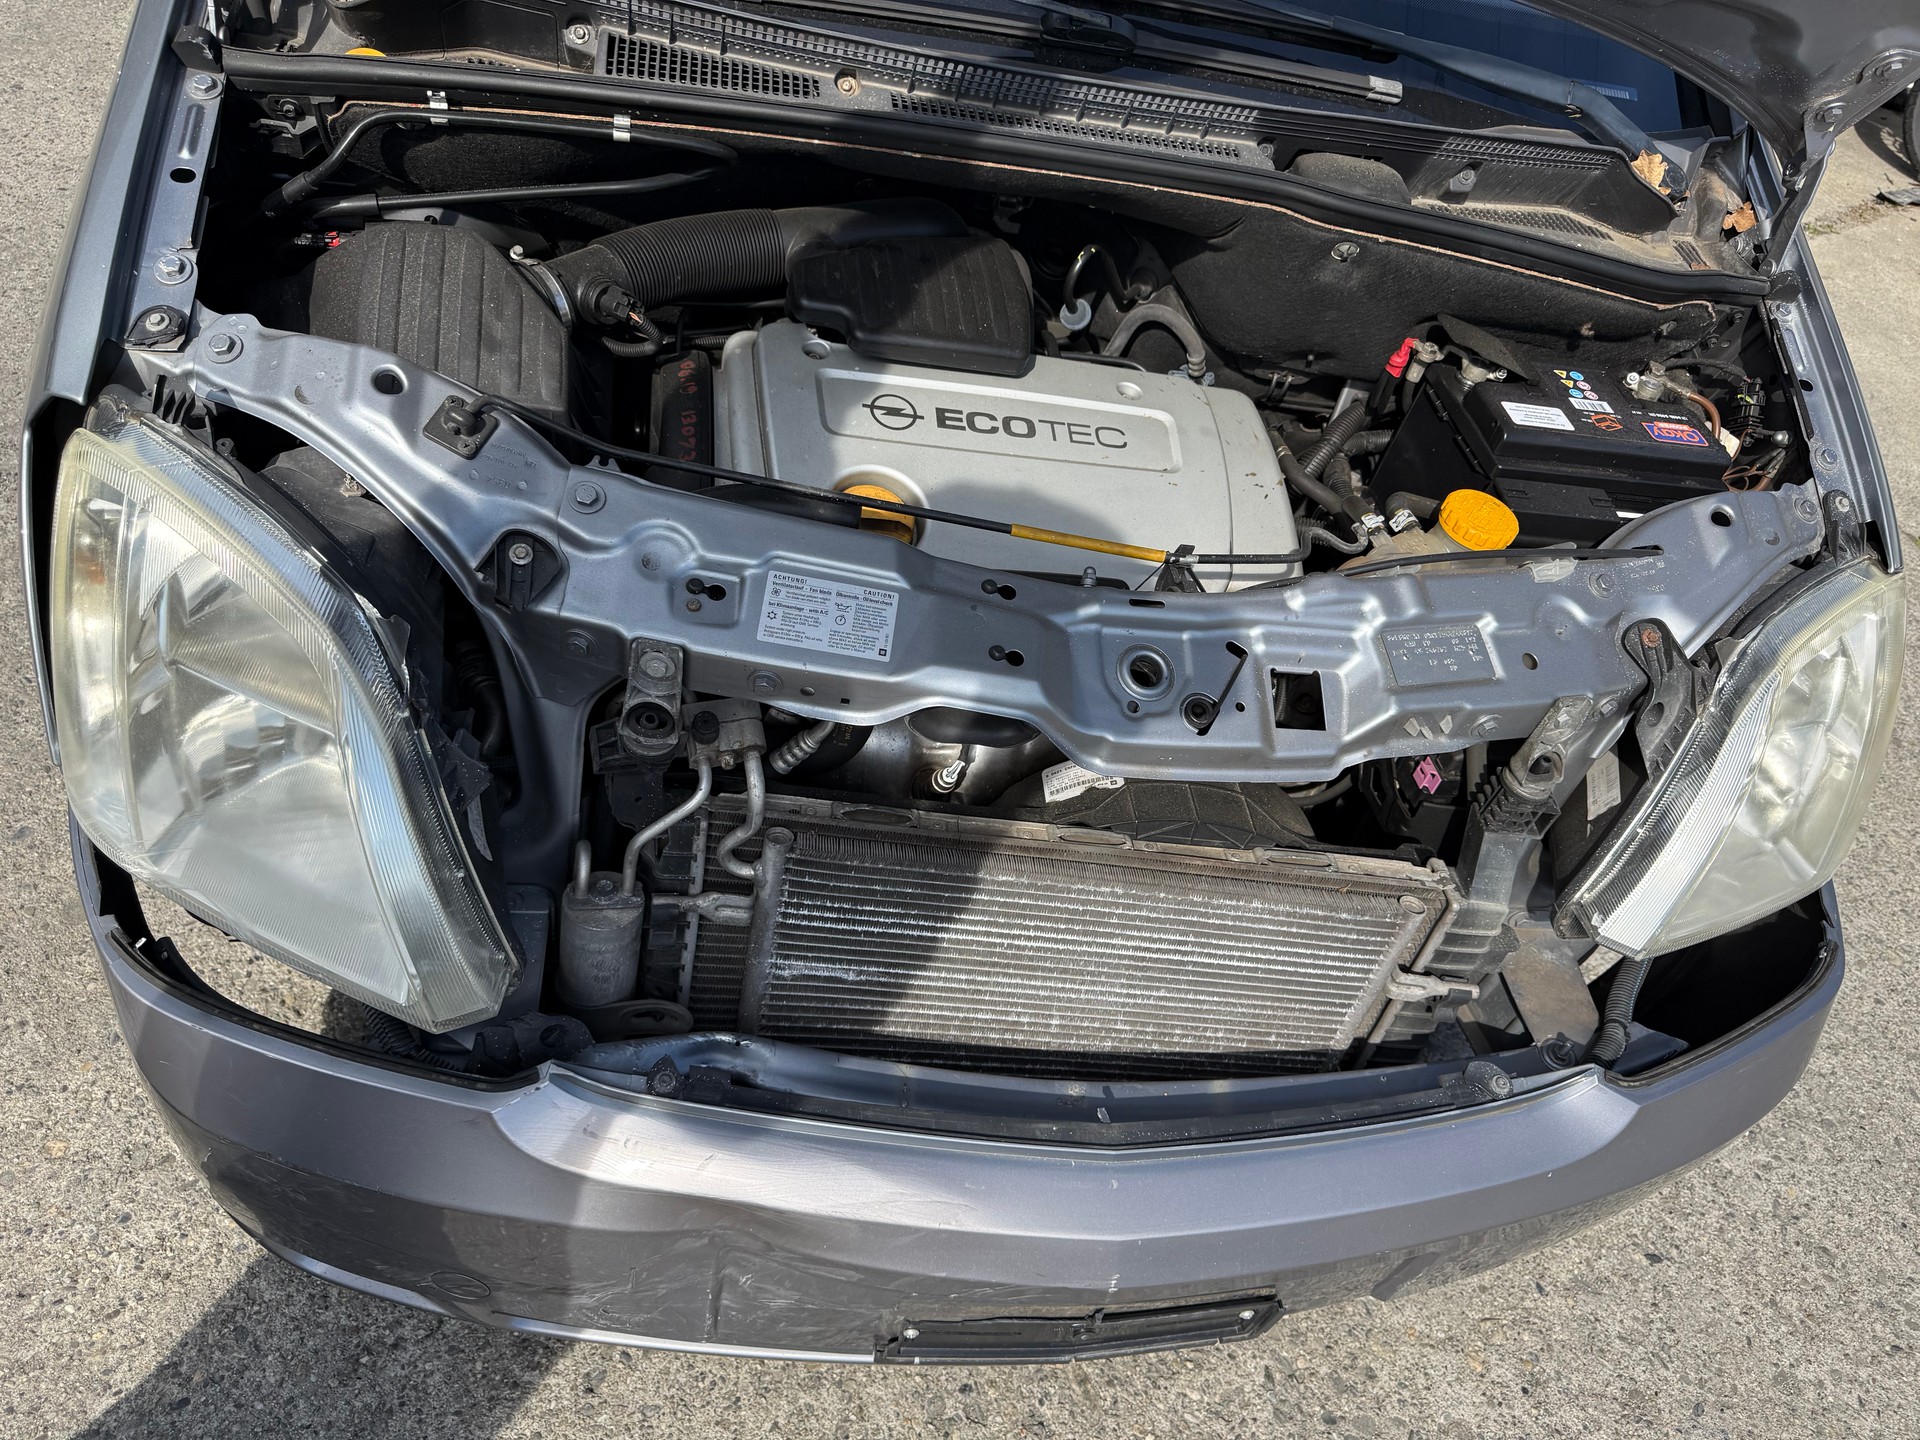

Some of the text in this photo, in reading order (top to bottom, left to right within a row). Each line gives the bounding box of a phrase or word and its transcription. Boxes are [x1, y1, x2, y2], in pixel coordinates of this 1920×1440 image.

[935, 407, 1128, 449] ECOTEC
[1654, 425, 1700, 442] Okay
[773, 573, 808, 584] ACHTUNG!
[863, 589, 895, 600] CAUTION!
